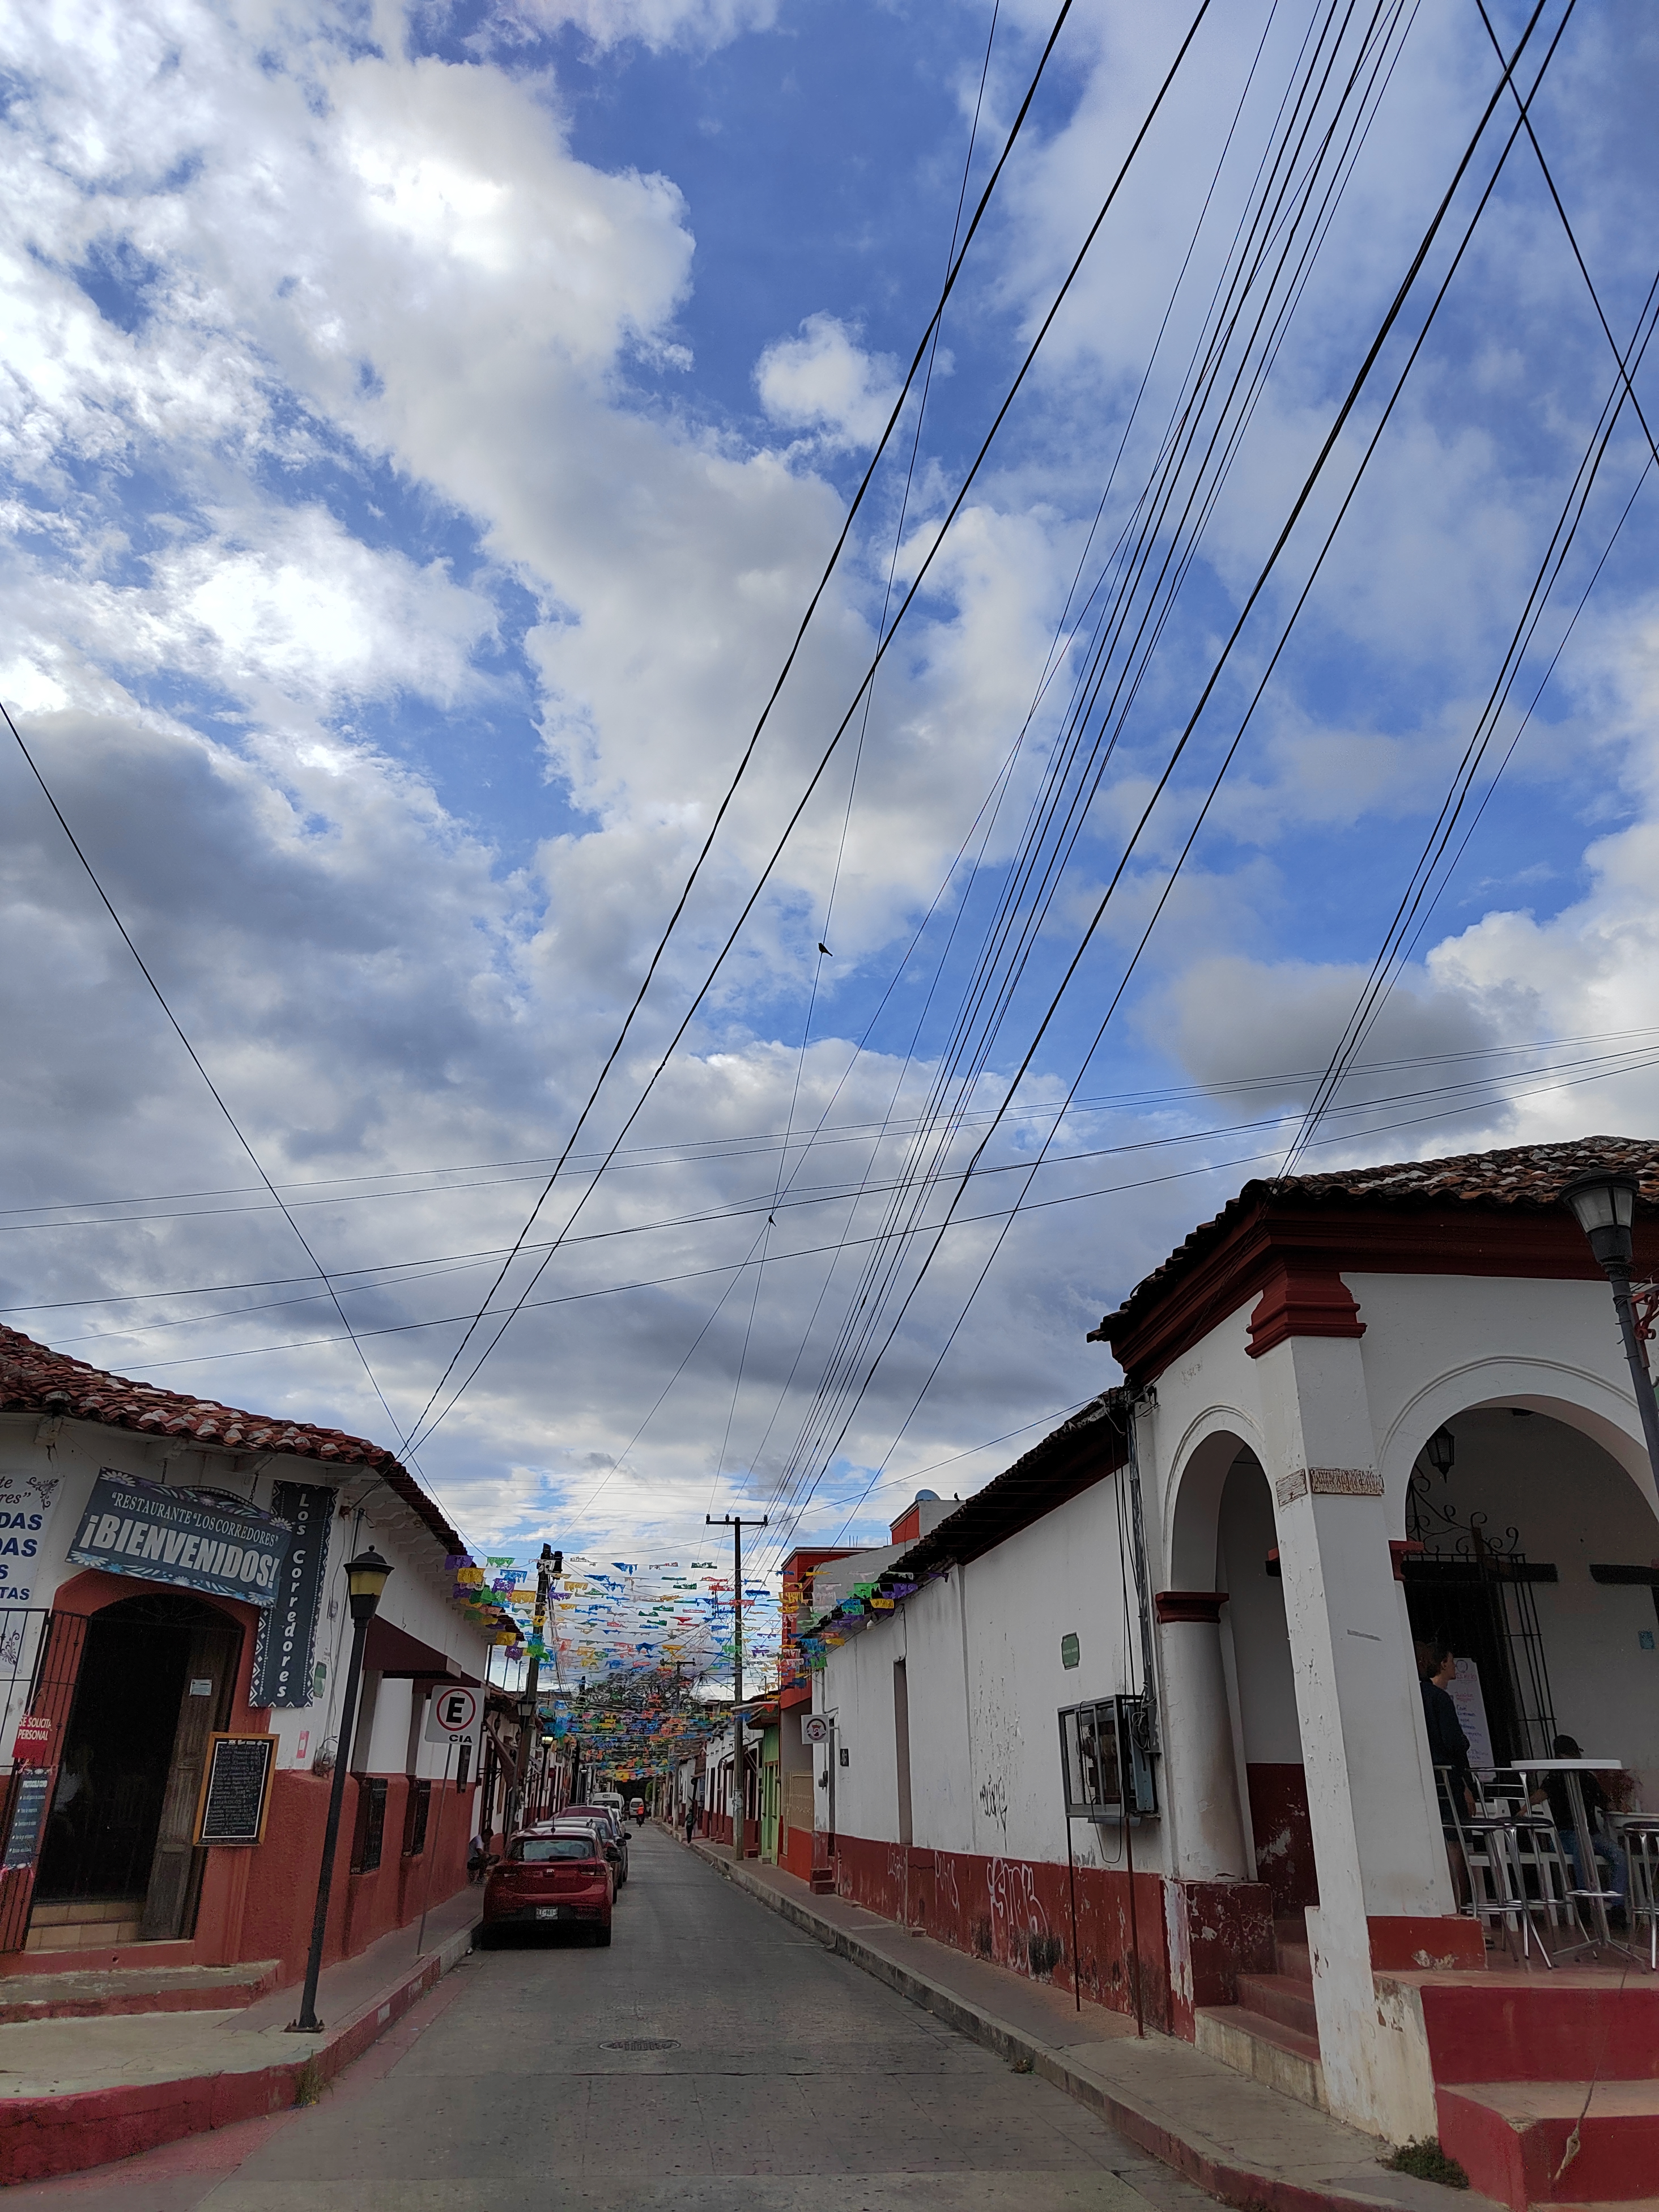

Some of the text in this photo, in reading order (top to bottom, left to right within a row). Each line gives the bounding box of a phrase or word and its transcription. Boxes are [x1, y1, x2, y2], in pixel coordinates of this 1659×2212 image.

[79, 1513, 280, 1590] ¡BIENVENIDOS!
[446, 1696, 465, 1724] E
[19, 1717, 27, 1727] SE
[18, 1729, 49, 1741] PERSONAL
[449, 1734, 473, 1743] CIA
